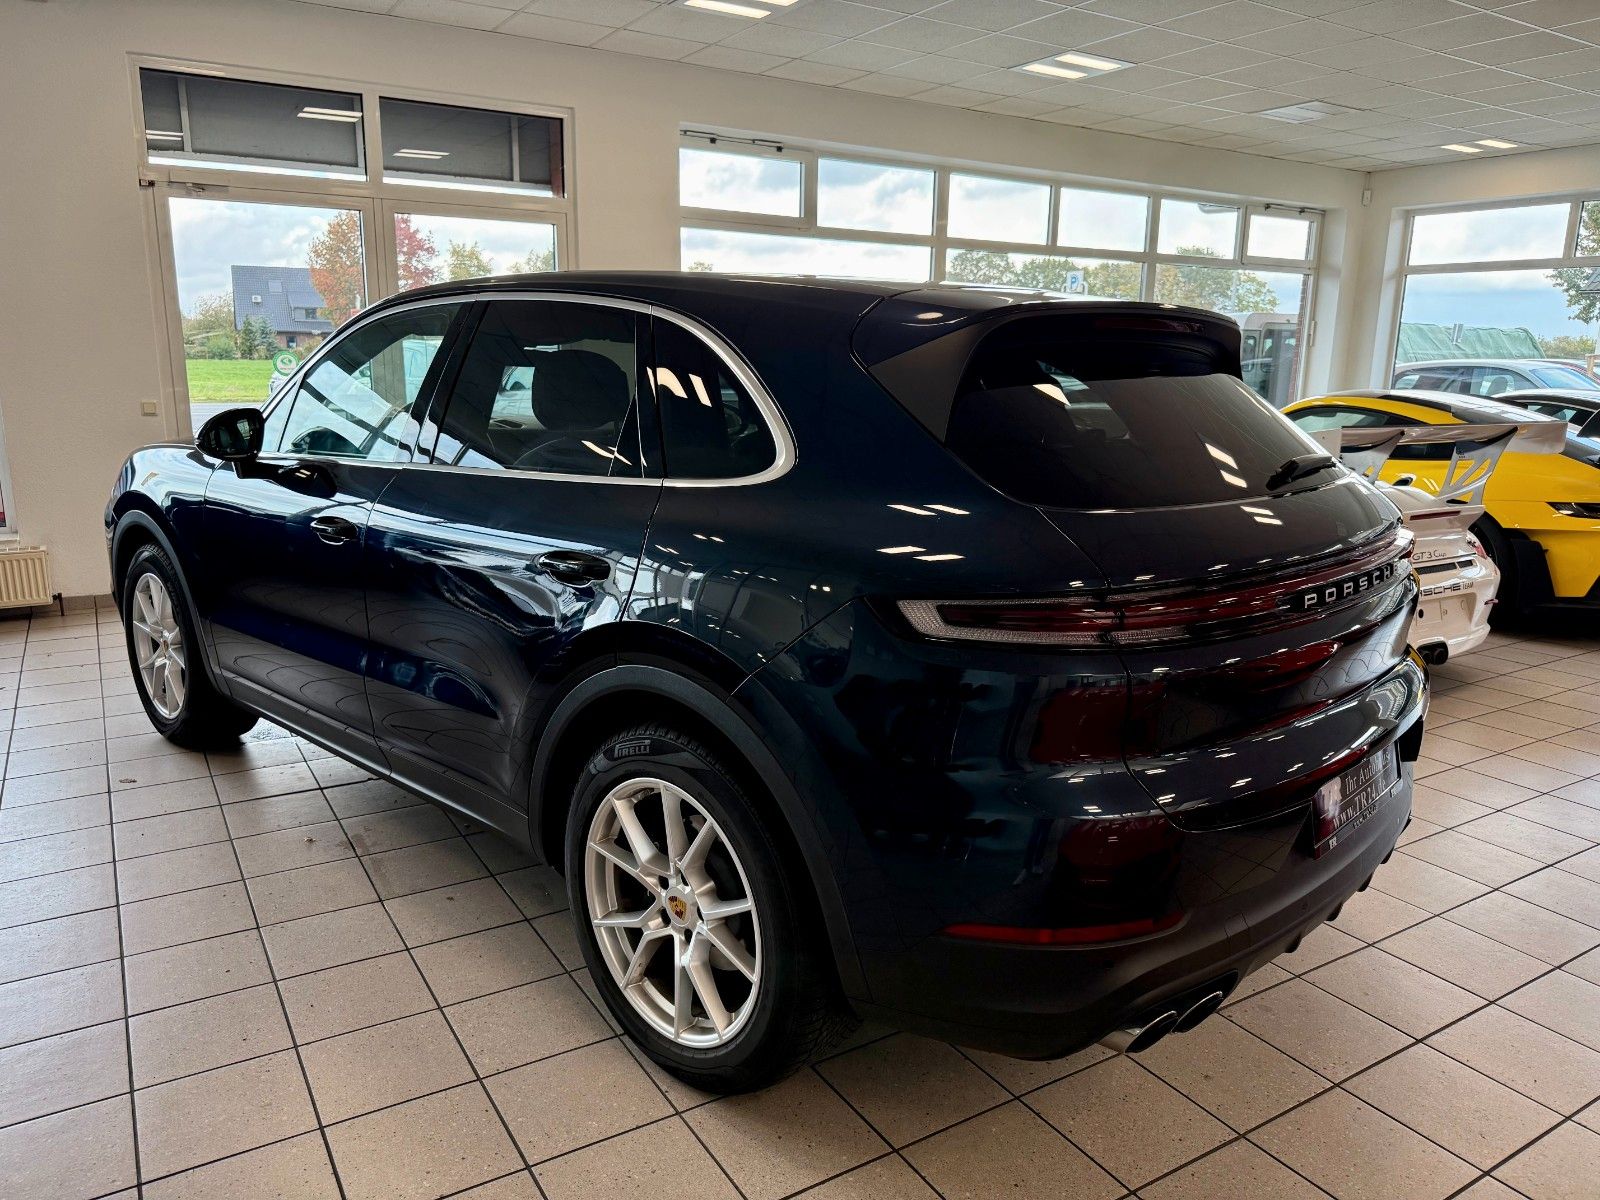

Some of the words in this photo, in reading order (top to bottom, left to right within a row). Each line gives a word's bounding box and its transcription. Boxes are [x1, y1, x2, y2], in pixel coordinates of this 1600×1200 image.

[1462, 581, 1474, 591] TEAM
[614, 739, 651, 758] PIRELLI
[1345, 774, 1357, 795] Ihr
[1333, 777, 1386, 830] www.TR24.de
